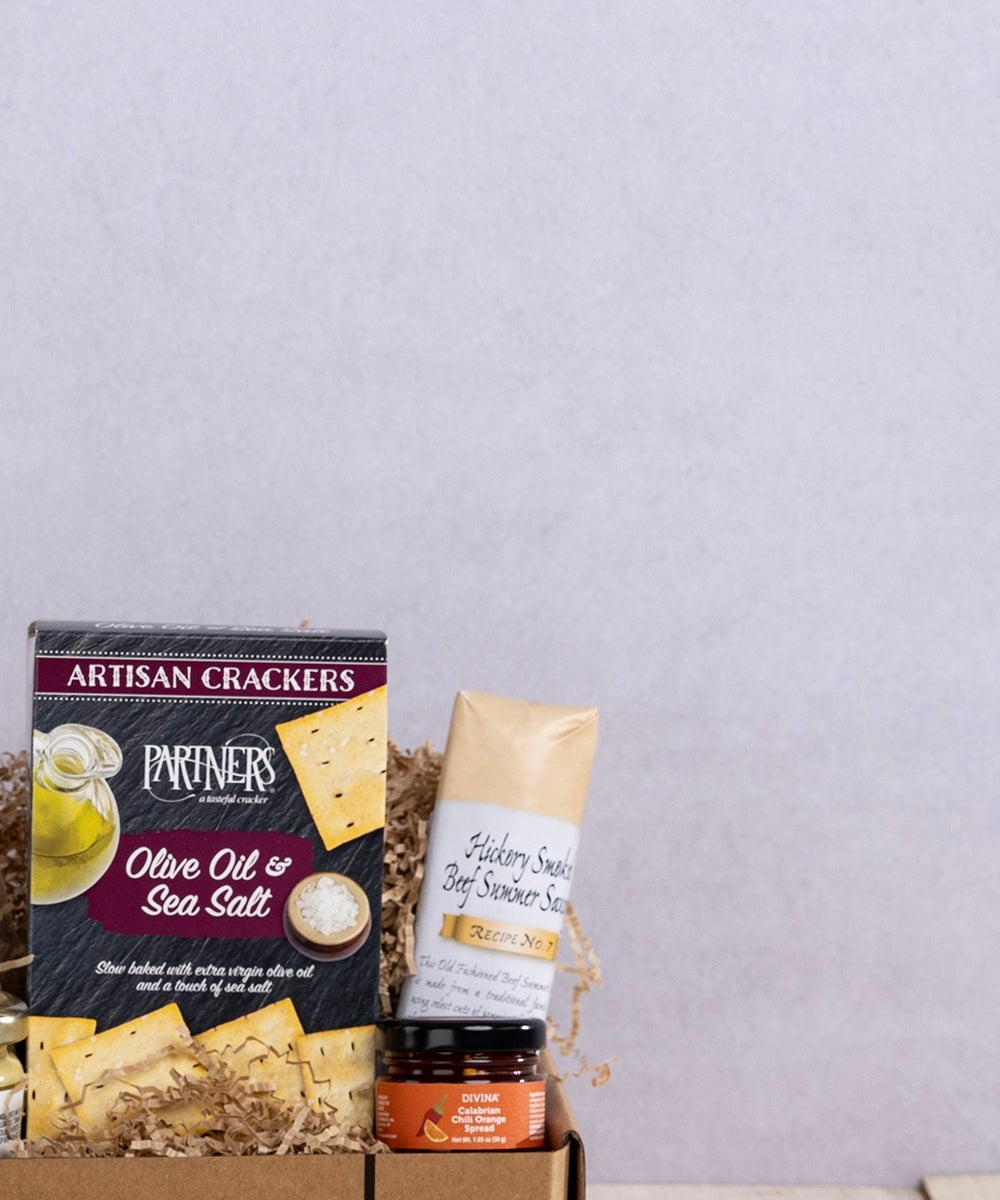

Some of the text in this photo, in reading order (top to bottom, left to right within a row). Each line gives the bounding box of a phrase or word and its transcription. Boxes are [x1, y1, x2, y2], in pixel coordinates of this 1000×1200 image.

[67, 664, 355, 692] ARTISAN CRACKERS
[142, 744, 276, 792] PARTNERS
[125, 846, 293, 881] Olive Oil &
[465, 831, 572, 884] Hickory Smok
[443, 860, 481, 909] Beef
[476, 870, 540, 907] Summer
[141, 884, 273, 918] Sea Salt
[95, 960, 315, 983] Slow baked with extra virgin olive oil
[136, 978, 274, 998] and a touch of sea salt
[457, 1106, 501, 1115] Calabrian
[462, 1093, 500, 1103] DIVINA
[451, 1115, 506, 1125] Chili Orange
[464, 1124, 495, 1134] Spread
